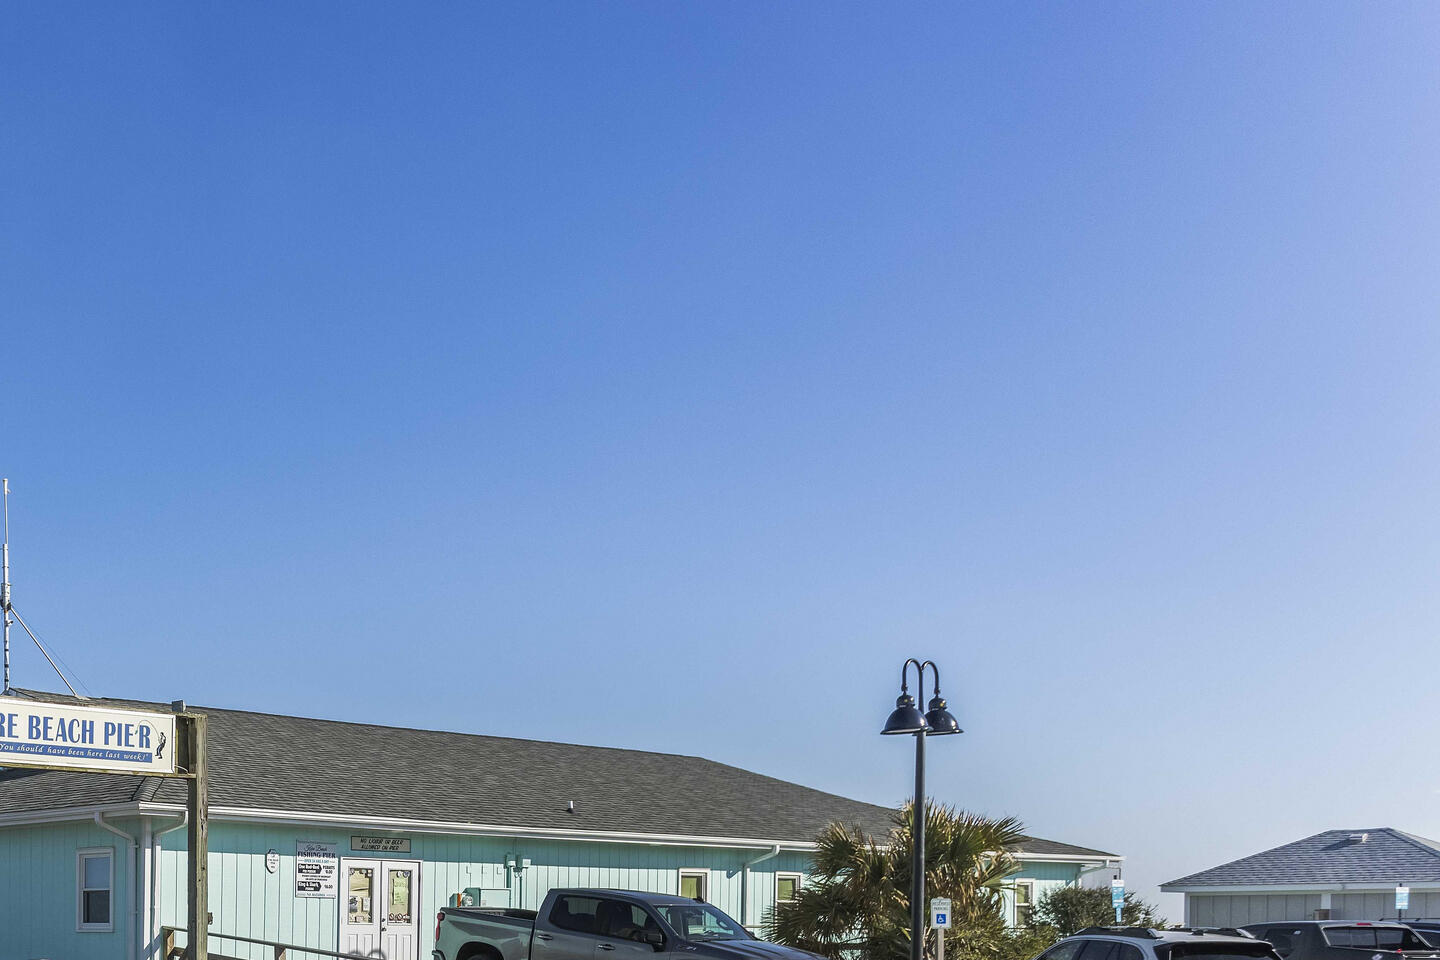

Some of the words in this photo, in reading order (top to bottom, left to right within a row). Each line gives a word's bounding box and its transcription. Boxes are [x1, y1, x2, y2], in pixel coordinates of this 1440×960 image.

[28, 714, 95, 744] BEACH
[104, 721, 151, 749] PIER
[16, 744, 44, 753] should
[47, 746, 65, 755] have
[68, 747, 84, 756] been
[87, 749, 103, 758] here
[105, 750, 120, 759] last
